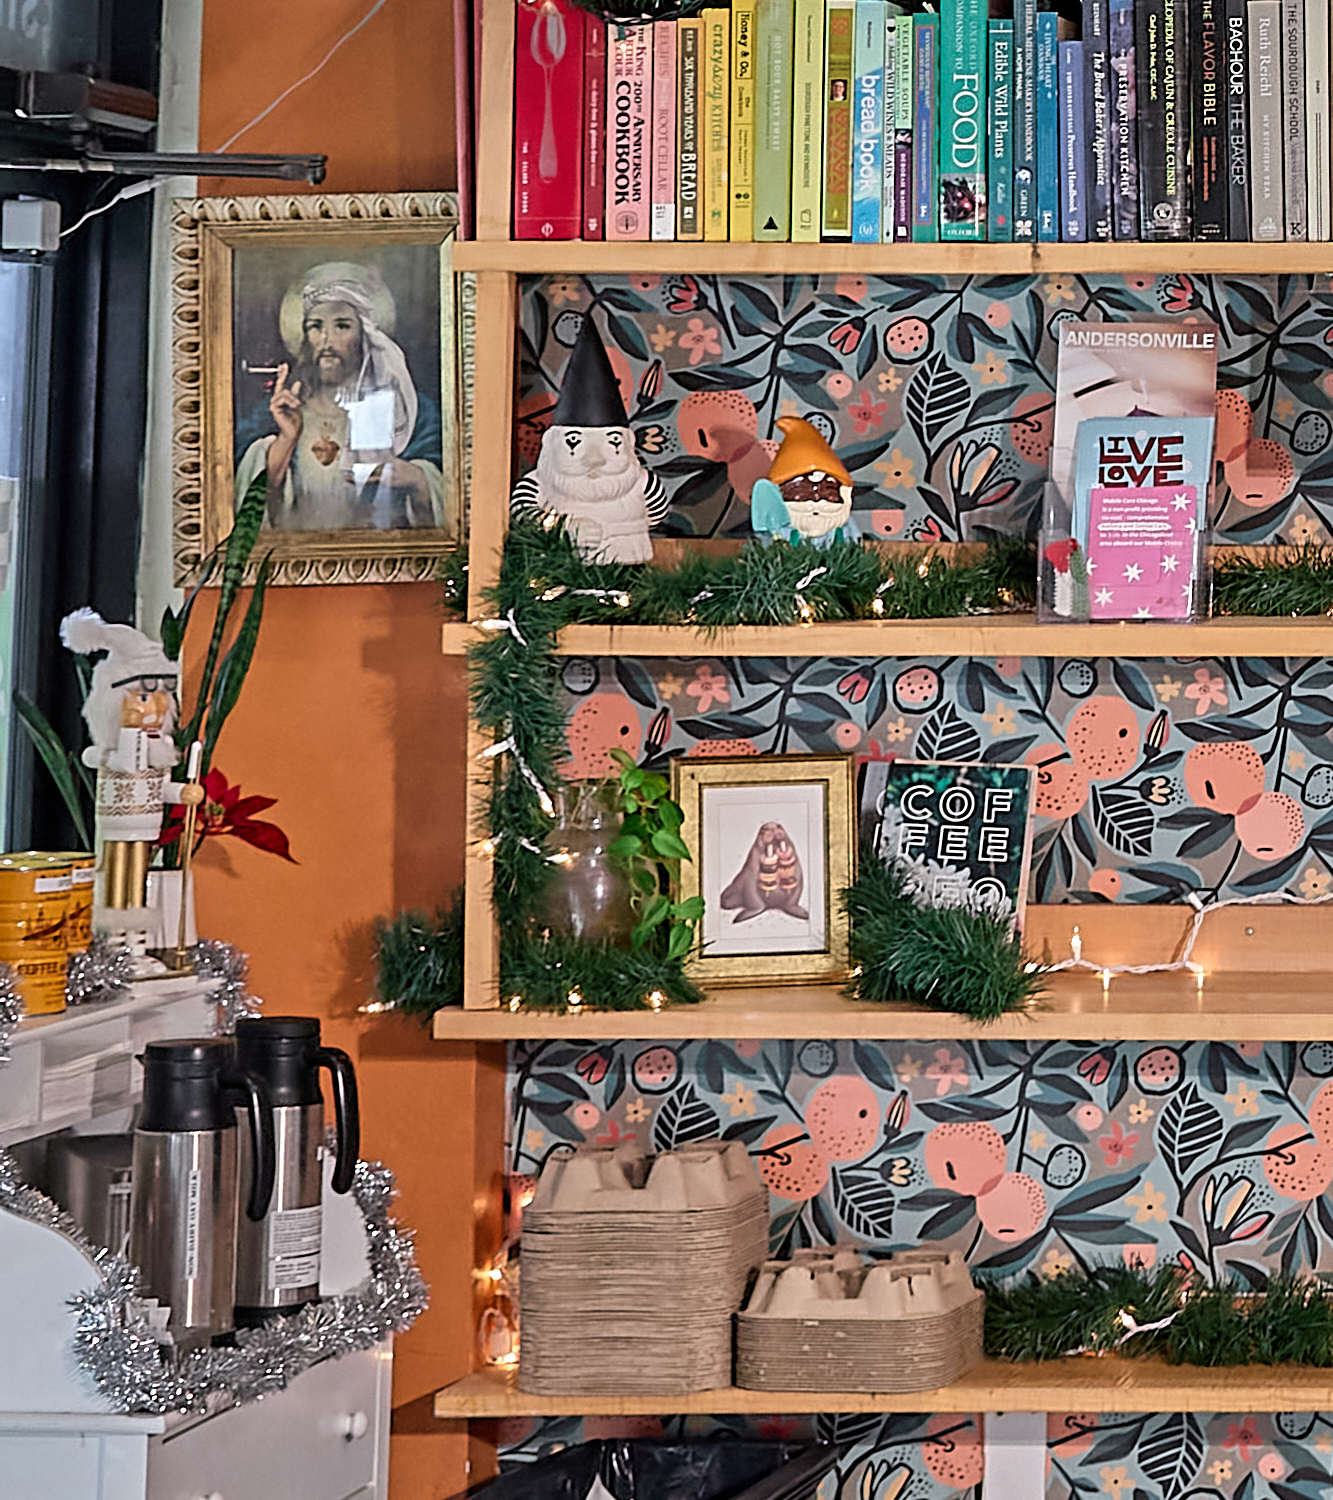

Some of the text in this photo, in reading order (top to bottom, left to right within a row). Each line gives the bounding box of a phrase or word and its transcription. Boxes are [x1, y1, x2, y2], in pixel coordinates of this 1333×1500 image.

[738, 14, 750, 46] Honey
[1202, 0, 1212, 20] THE
[635, 46, 647, 76] KING
[739, 61, 749, 77] Co.
[901, 23, 910, 121] VEGETABLE SOUPS
[955, 57, 963, 70] TO
[1165, 49, 1174, 64] OF
[1203, 22, 1215, 81] FLAVOR
[1259, 17, 1271, 97] Ruth Reichl
[1164, 66, 1175, 100] CAJUN
[1288, 4, 1299, 141] THE SOURDOUGH SCHOOL
[952, 73, 979, 168] FOOD
[994, 42, 1008, 158] Edible Wild Plants
[1094, 52, 1106, 185] The Bread Baker's Apprentice
[1165, 102, 1175, 111] &
[1203, 83, 1216, 125] BIBLE
[1229, 18, 1246, 185] BACHOUR THE BAKER
[615, 80, 630, 205] COOKBOOK
[860, 75, 878, 191] bread book
[1118, 63, 1129, 196] PRESERVATION KITCHEN
[1165, 112, 1175, 153] CREOLE
[632, 116, 644, 205] ANNIVERSARY
[657, 145, 668, 191] CELLAR
[1165, 155, 1176, 196] CUISINE
[1065, 330, 1214, 349] ANDERSONVILLE
[1099, 436, 1184, 464] LIVE
[1099, 465, 1184, 489] LOVE
[900, 785, 1013, 823] COF
[898, 823, 1009, 862] FEE
